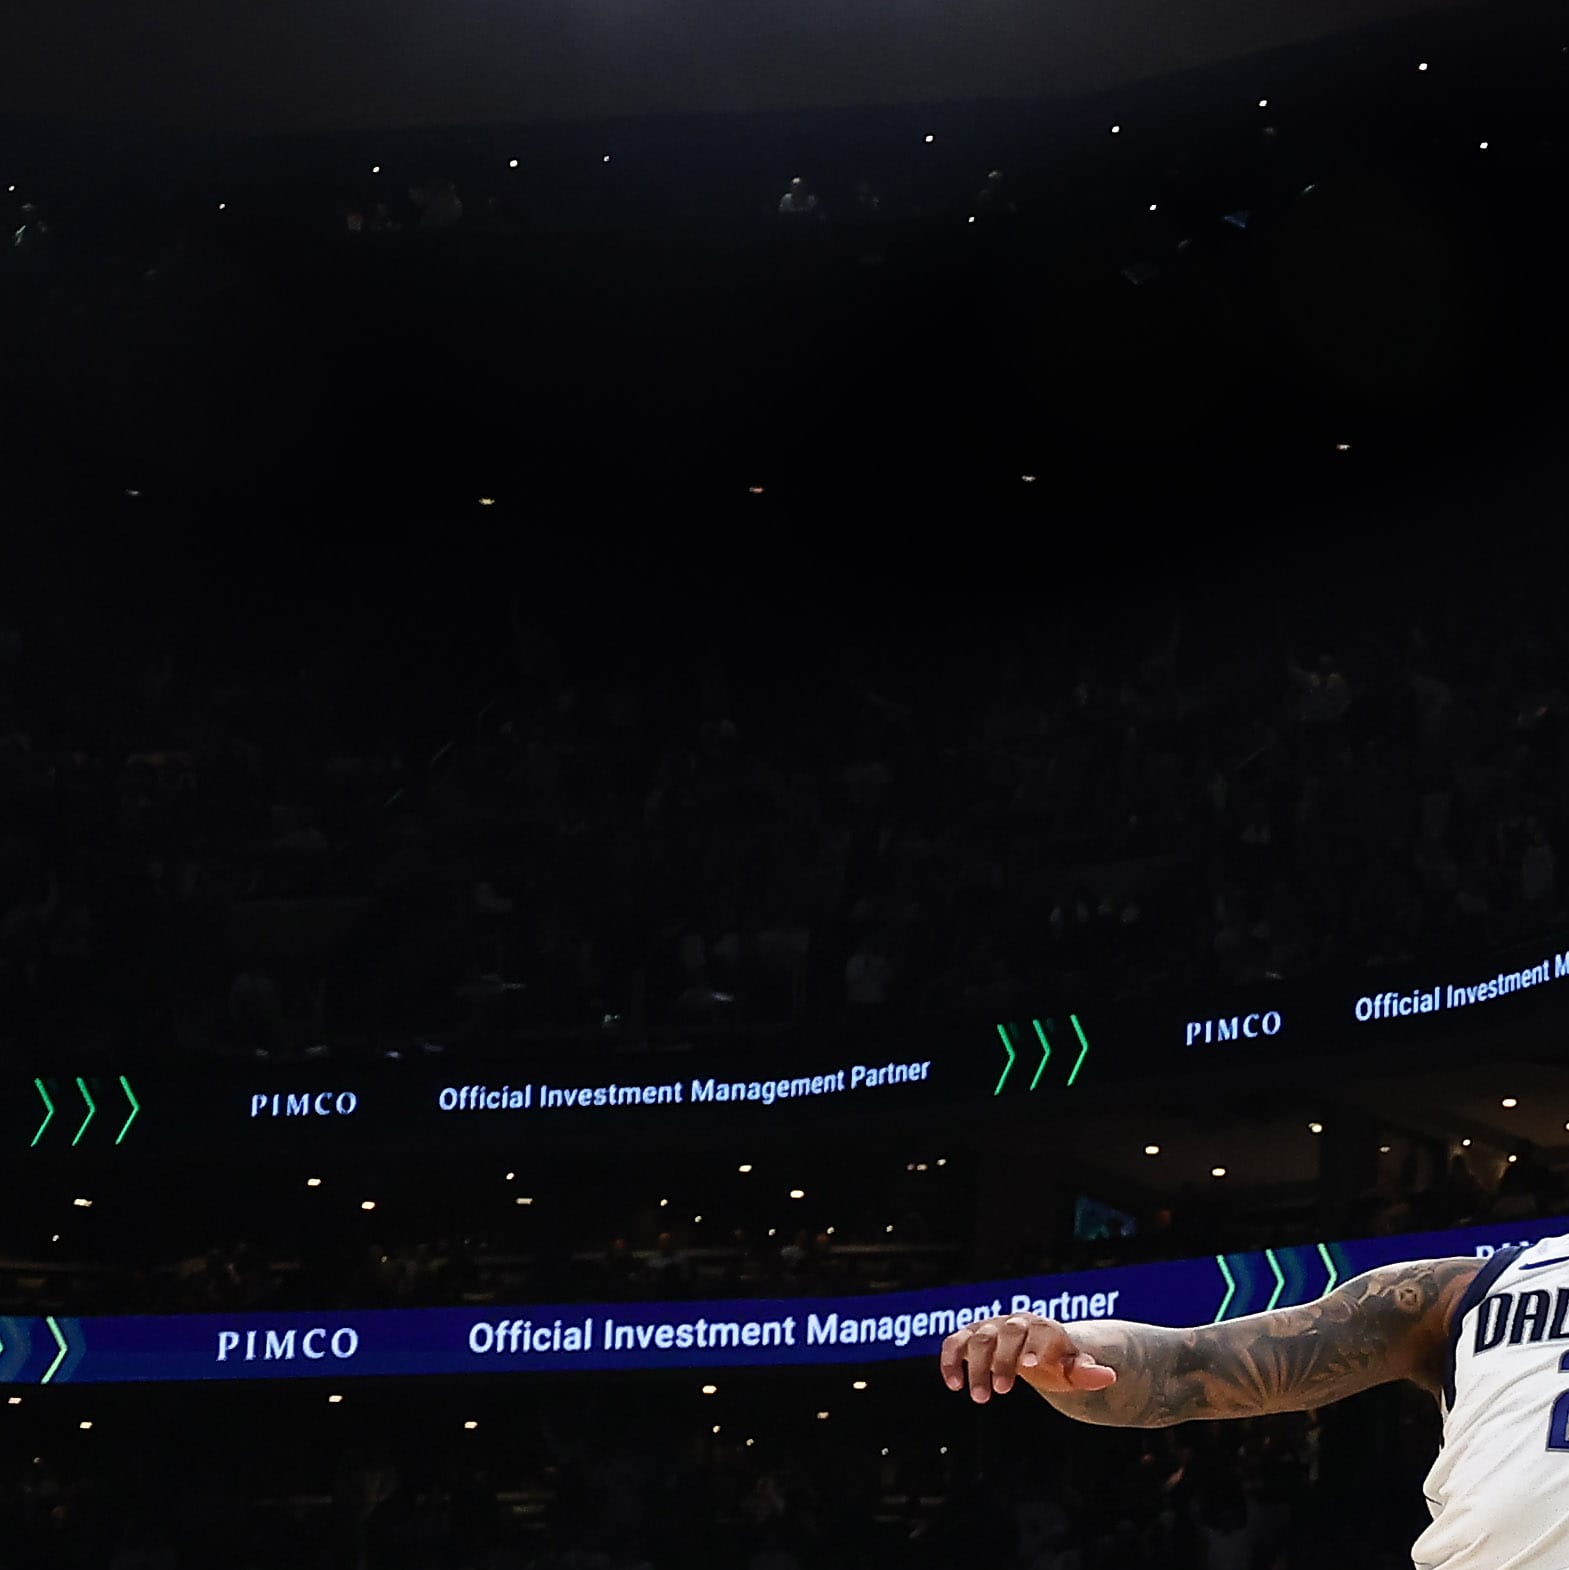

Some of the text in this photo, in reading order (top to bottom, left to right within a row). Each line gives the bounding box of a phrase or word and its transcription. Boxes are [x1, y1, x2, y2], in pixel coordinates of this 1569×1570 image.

[1355, 986, 1441, 1022] Official
[1446, 960, 1550, 1009] Investment
[1186, 1011, 1281, 1046] PIMCO
[439, 1061, 931, 1110] Official Investment Management Partner
[251, 1092, 357, 1117] PIMCO
[217, 1327, 358, 1361] PIMCO
[469, 1317, 593, 1353] Official
[604, 1316, 796, 1350] Investment
